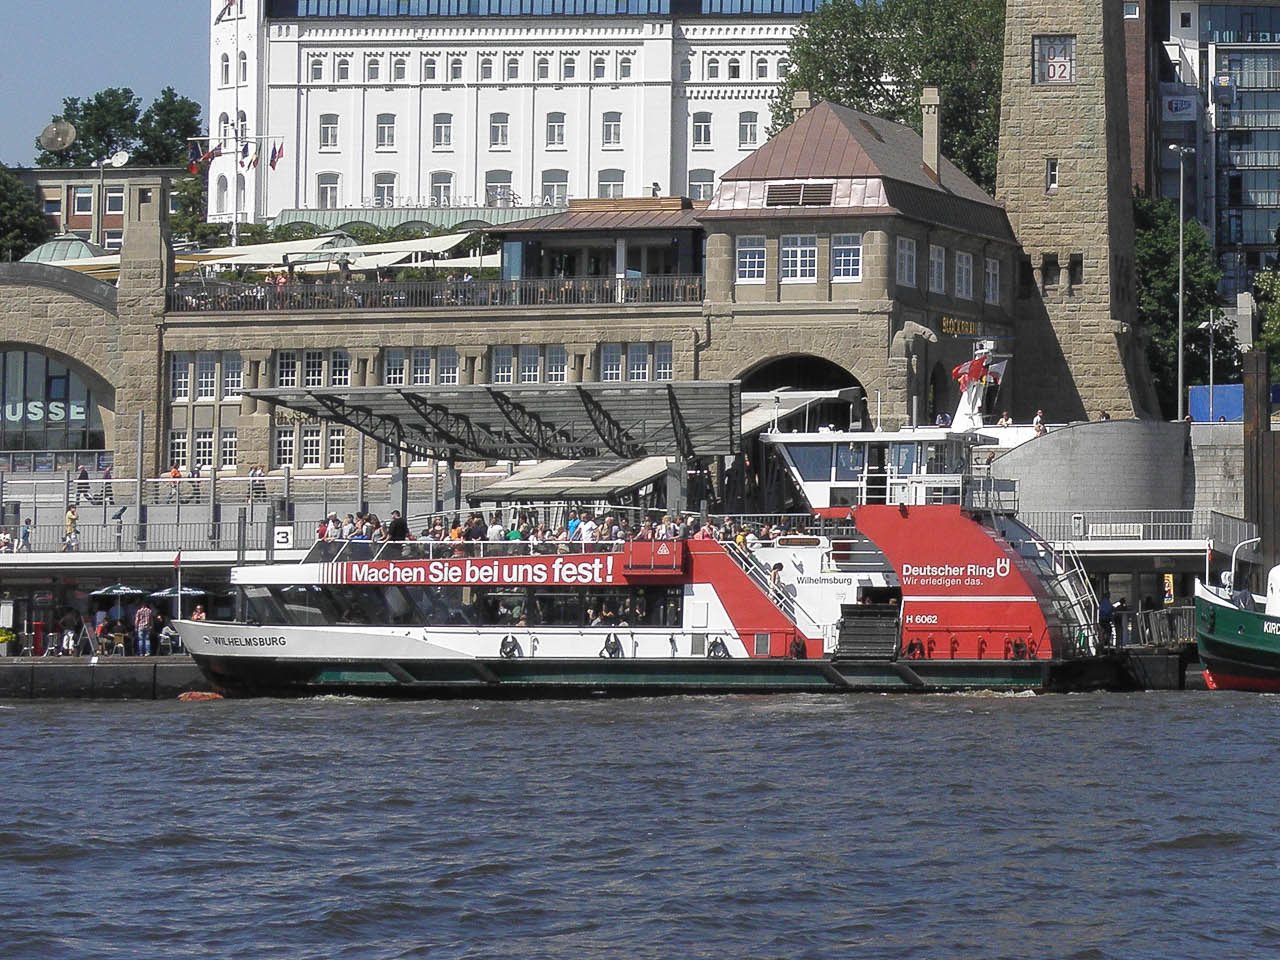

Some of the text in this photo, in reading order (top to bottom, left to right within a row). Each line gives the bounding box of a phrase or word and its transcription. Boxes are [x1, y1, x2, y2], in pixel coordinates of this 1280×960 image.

[1047, 63, 1067, 79] 02
[0, 401, 86, 421] USSE
[276, 531, 289, 544] 3
[351, 562, 425, 583] Machen
[428, 561, 461, 583] Sie
[465, 559, 499, 583] bei
[502, 562, 548, 583] uns
[902, 564, 995, 578] Deutscher Ring
[796, 576, 853, 585] Wilhelmsburg
[902, 577, 984, 587] Wir erledigen das.
[905, 615, 938, 624] H 6062
[212, 636, 287, 647] WILHELMSBURG
